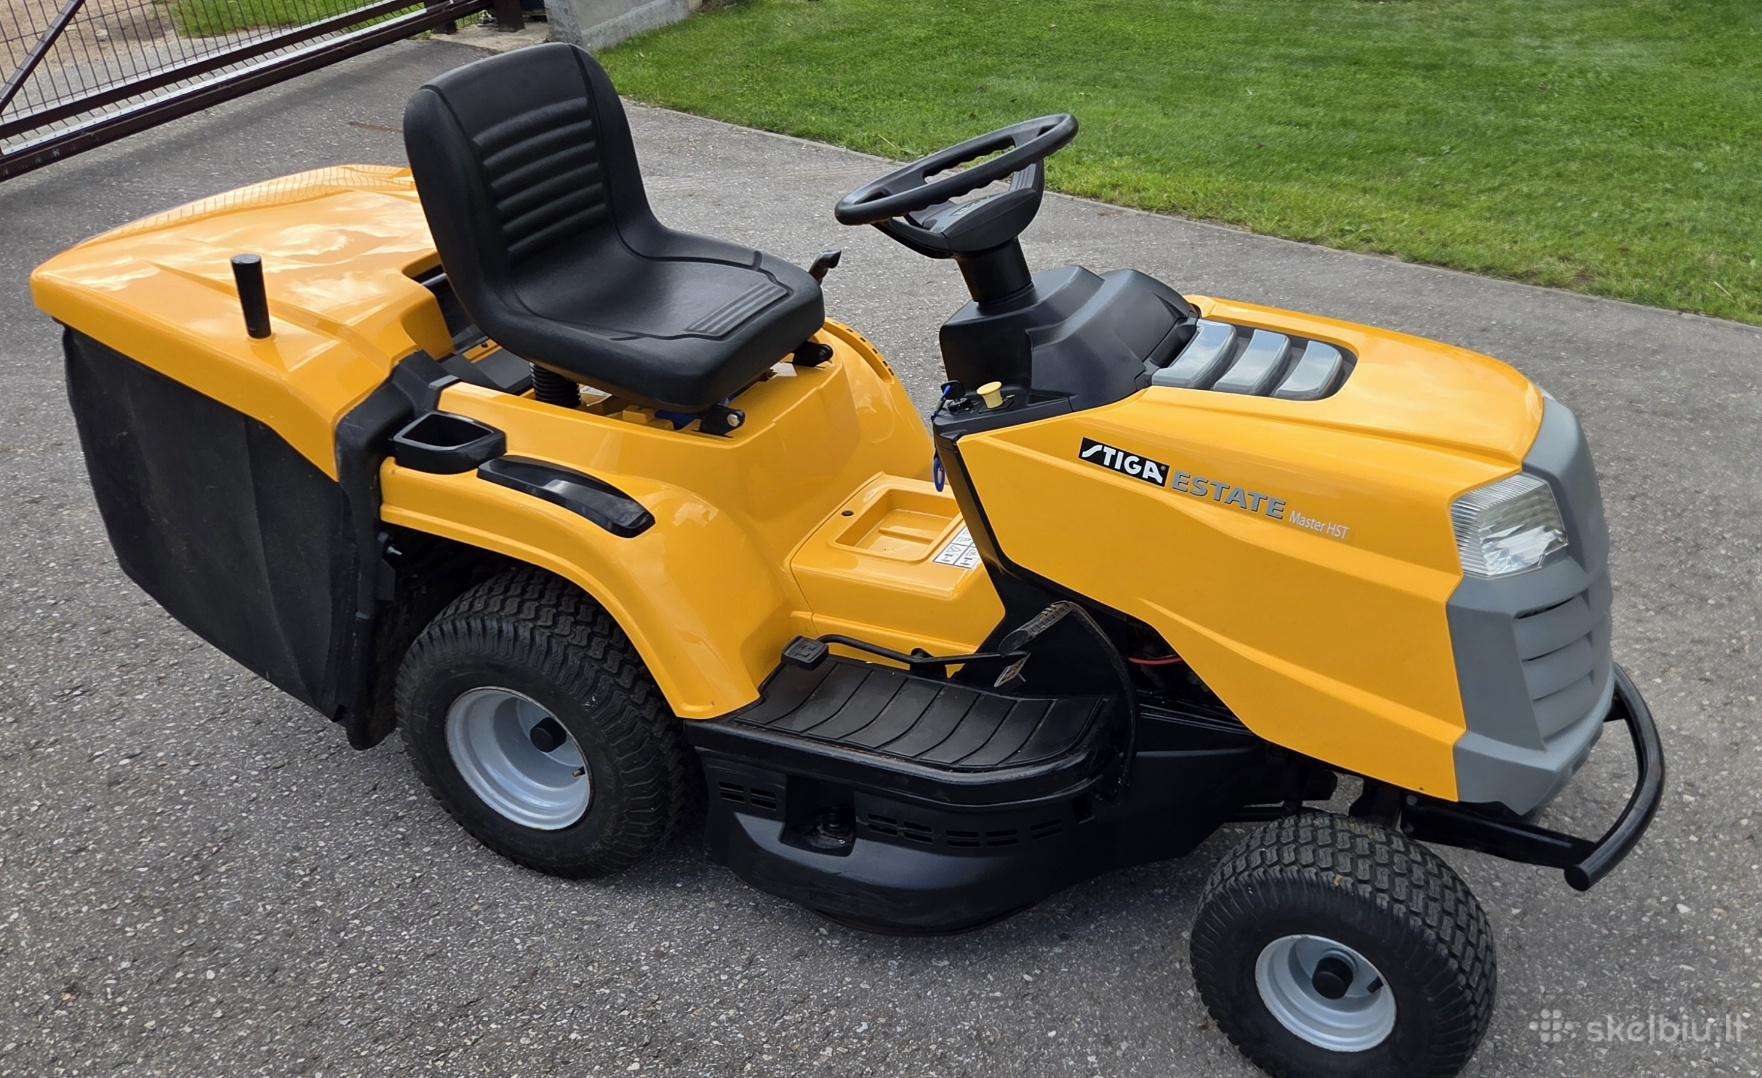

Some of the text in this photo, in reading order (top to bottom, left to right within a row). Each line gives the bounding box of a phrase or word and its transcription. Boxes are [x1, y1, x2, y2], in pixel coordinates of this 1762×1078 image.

[1081, 444, 1287, 520] STIGA ESTATE
[1288, 509, 1350, 540] Master HST
